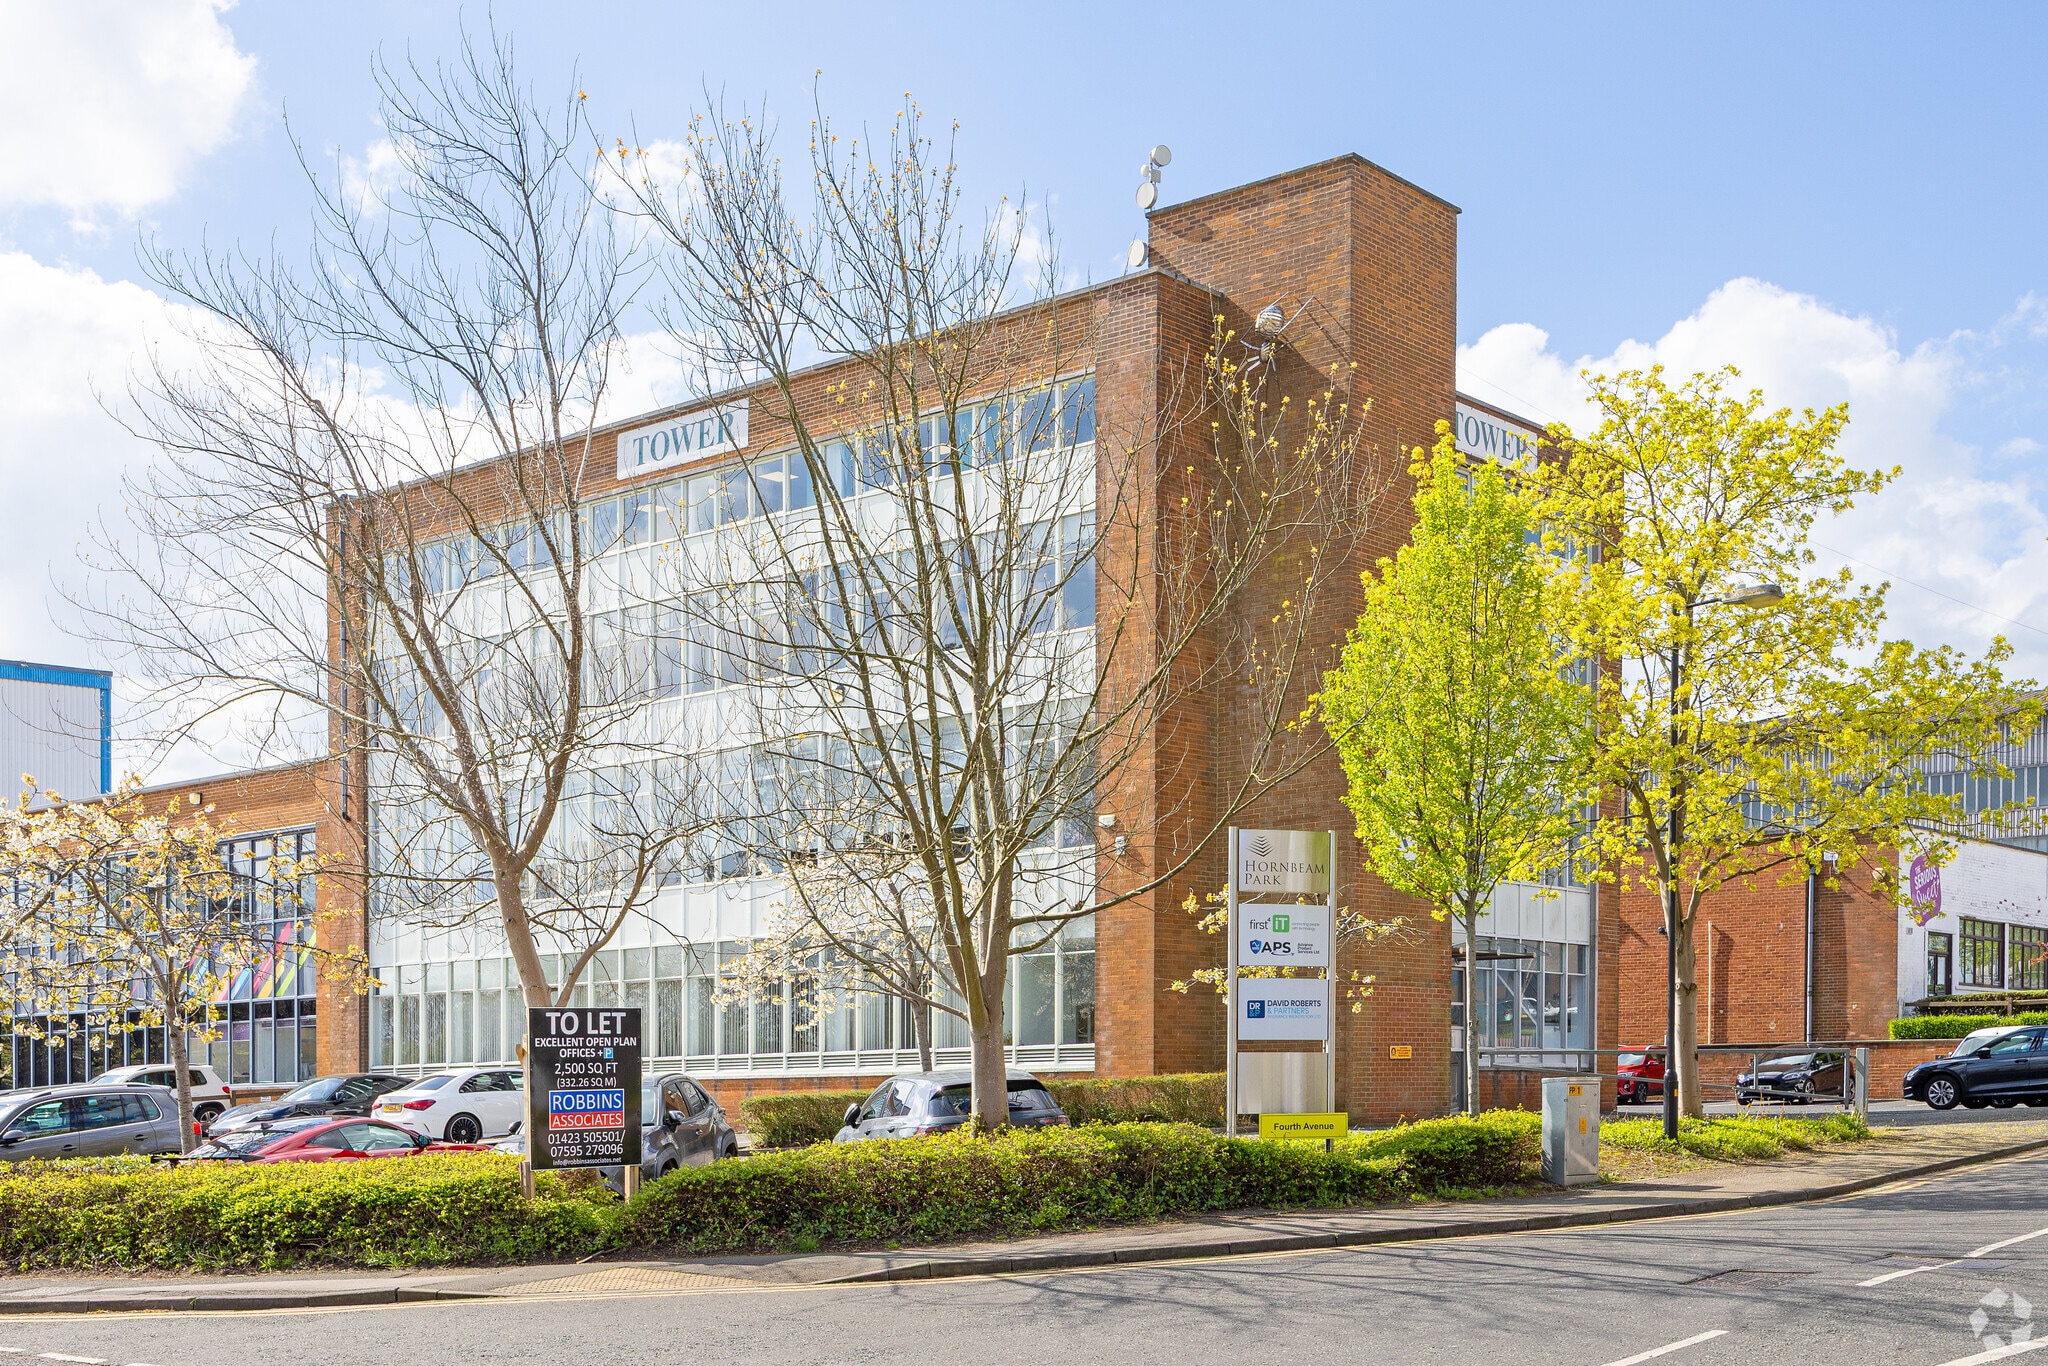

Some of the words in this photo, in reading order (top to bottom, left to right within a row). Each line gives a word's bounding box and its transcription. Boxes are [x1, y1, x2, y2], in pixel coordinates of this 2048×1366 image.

[633, 413, 735, 466] TOWER
[1245, 860, 1325, 874] HORNBEAM
[1245, 873, 1281, 885] PARK
[1261, 941, 1291, 954] APS
[1249, 1002, 1260, 1010] DR
[545, 1011, 579, 1035] TO
[587, 1011, 626, 1034] LET
[534, 1037, 584, 1047] EXCELLENT
[586, 1037, 611, 1047] OPEN
[613, 1037, 637, 1046] PLAN
[559, 1048, 596, 1058] OFFICES
[554, 1062, 585, 1076] 2,500
[587, 1062, 603, 1075] SQ
[605, 1062, 618, 1073] FT
[557, 1078, 589, 1089] (332.26
[590, 1078, 603, 1088] SQ
[604, 1077, 617, 1088] M)
[553, 1093, 622, 1111] ROBBINS
[552, 1113, 622, 1127] ASSOCIATES
[1273, 1122, 1301, 1131] Fourth
[1303, 1122, 1334, 1130] Avenue
[548, 1133, 580, 1145] 01423
[583, 1129, 626, 1143] 505501/
[550, 1145, 583, 1157] 07595
[585, 1144, 624, 1156] 279096
[552, 1157, 622, 1167] info@robbinsassociates.net
